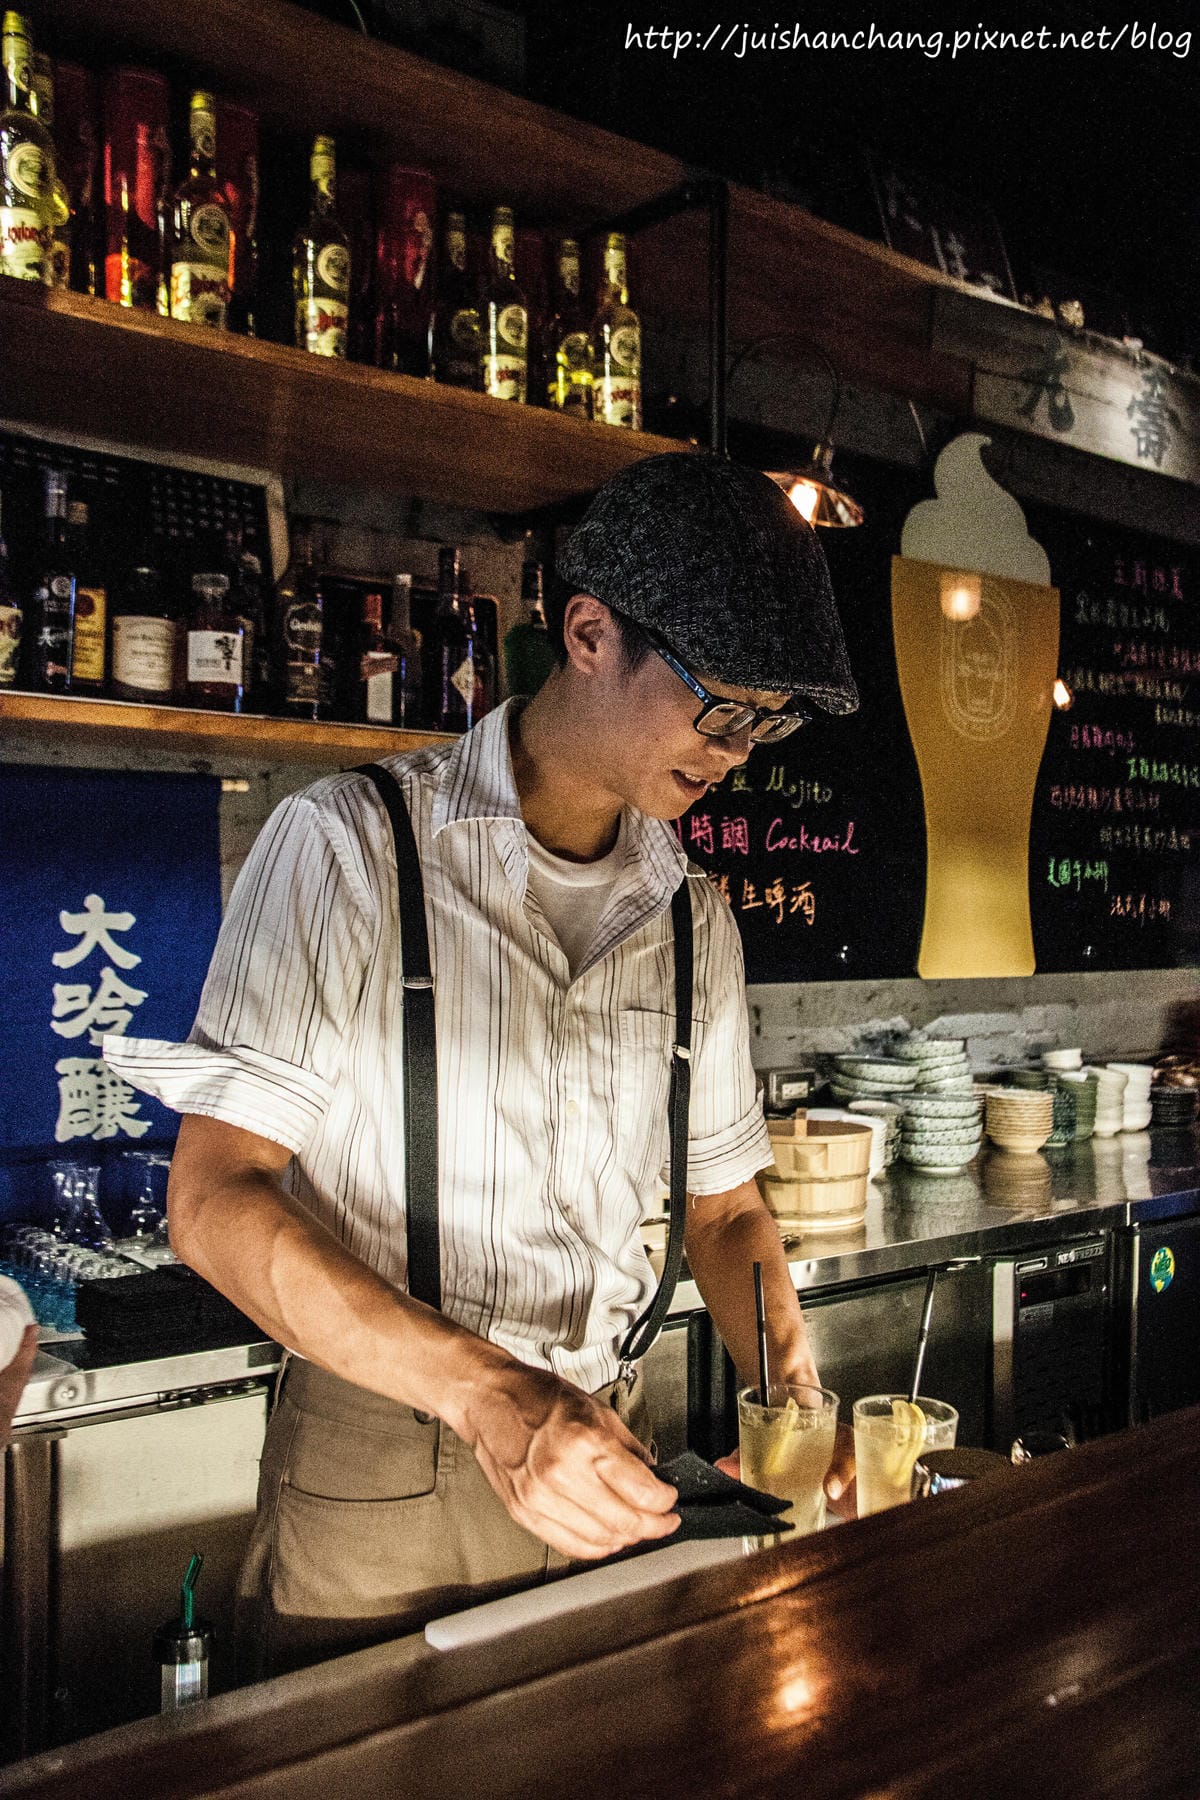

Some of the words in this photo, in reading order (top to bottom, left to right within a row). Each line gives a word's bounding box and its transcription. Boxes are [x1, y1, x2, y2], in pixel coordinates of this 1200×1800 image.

[765, 765, 833, 809] Mojito
[676, 813, 749, 855] 特調
[765, 817, 860, 855] Cocktail
